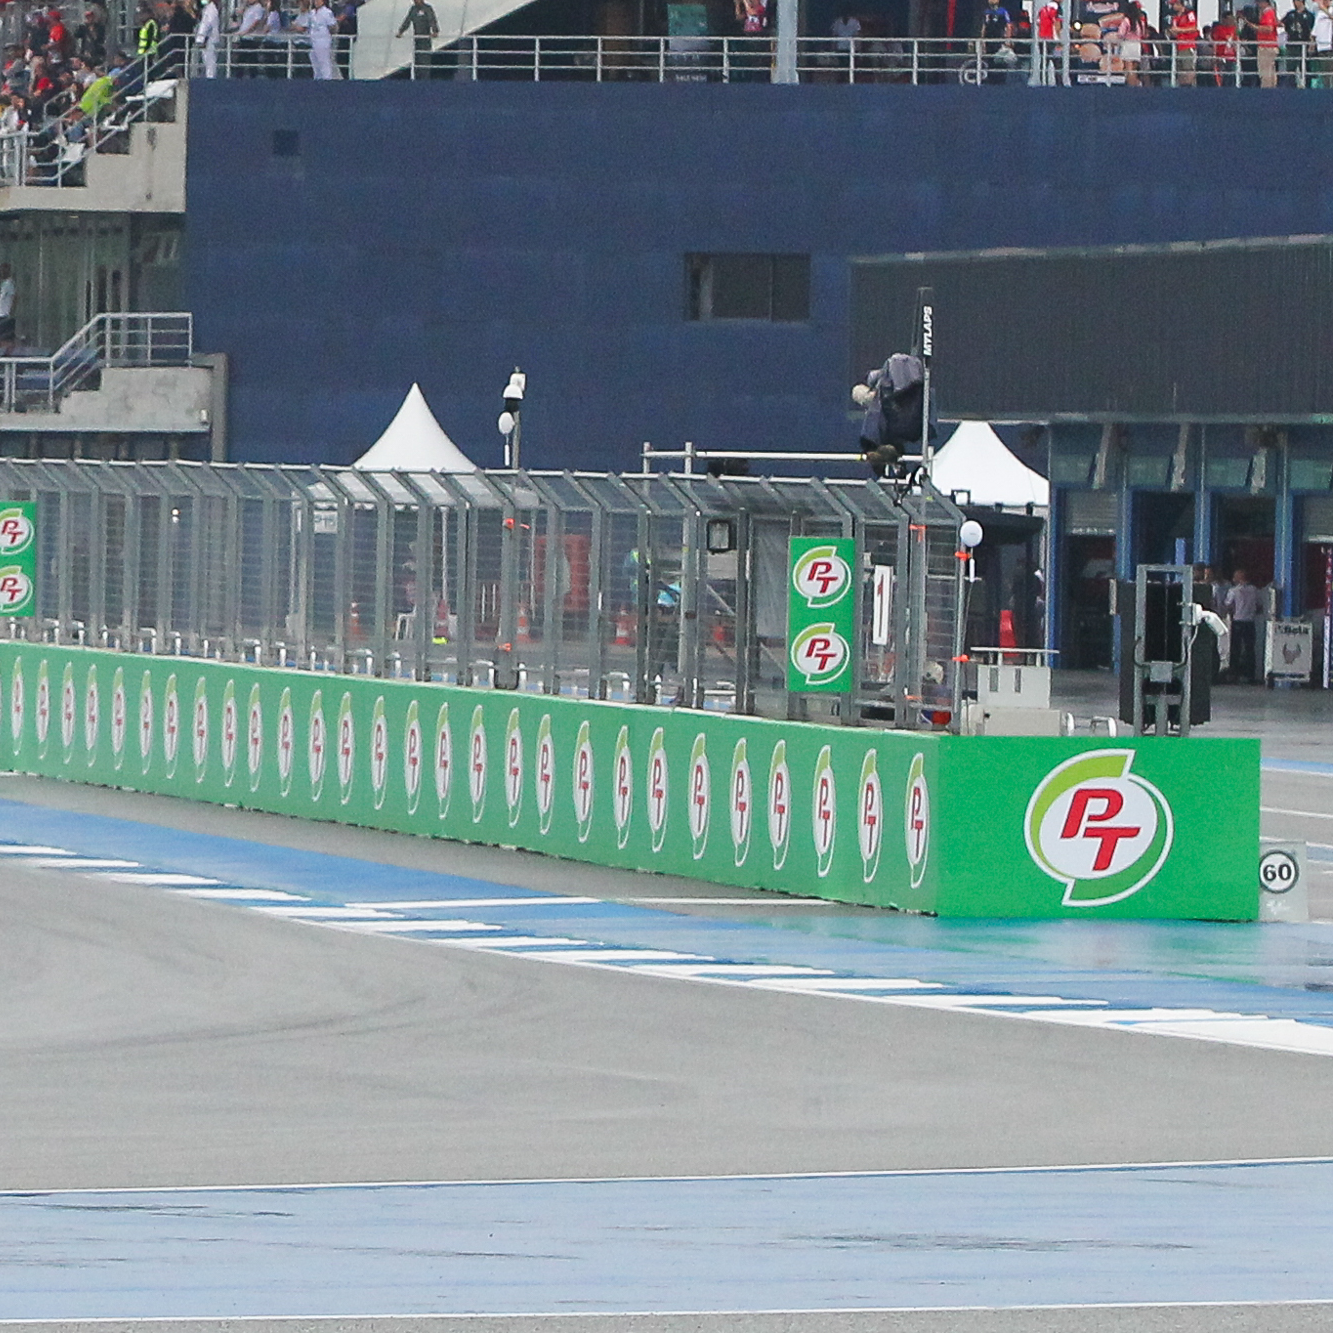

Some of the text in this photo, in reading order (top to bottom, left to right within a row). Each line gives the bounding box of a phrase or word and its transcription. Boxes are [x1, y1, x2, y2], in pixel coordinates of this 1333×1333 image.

[923, 305, 933, 357] MYLAPS
[1, 519, 24, 544] PT
[0, 576, 23, 602] PT
[807, 561, 838, 594] PT
[805, 638, 836, 671] PT
[1060, 788, 1141, 872] PT
[1262, 863, 1293, 882] 60
